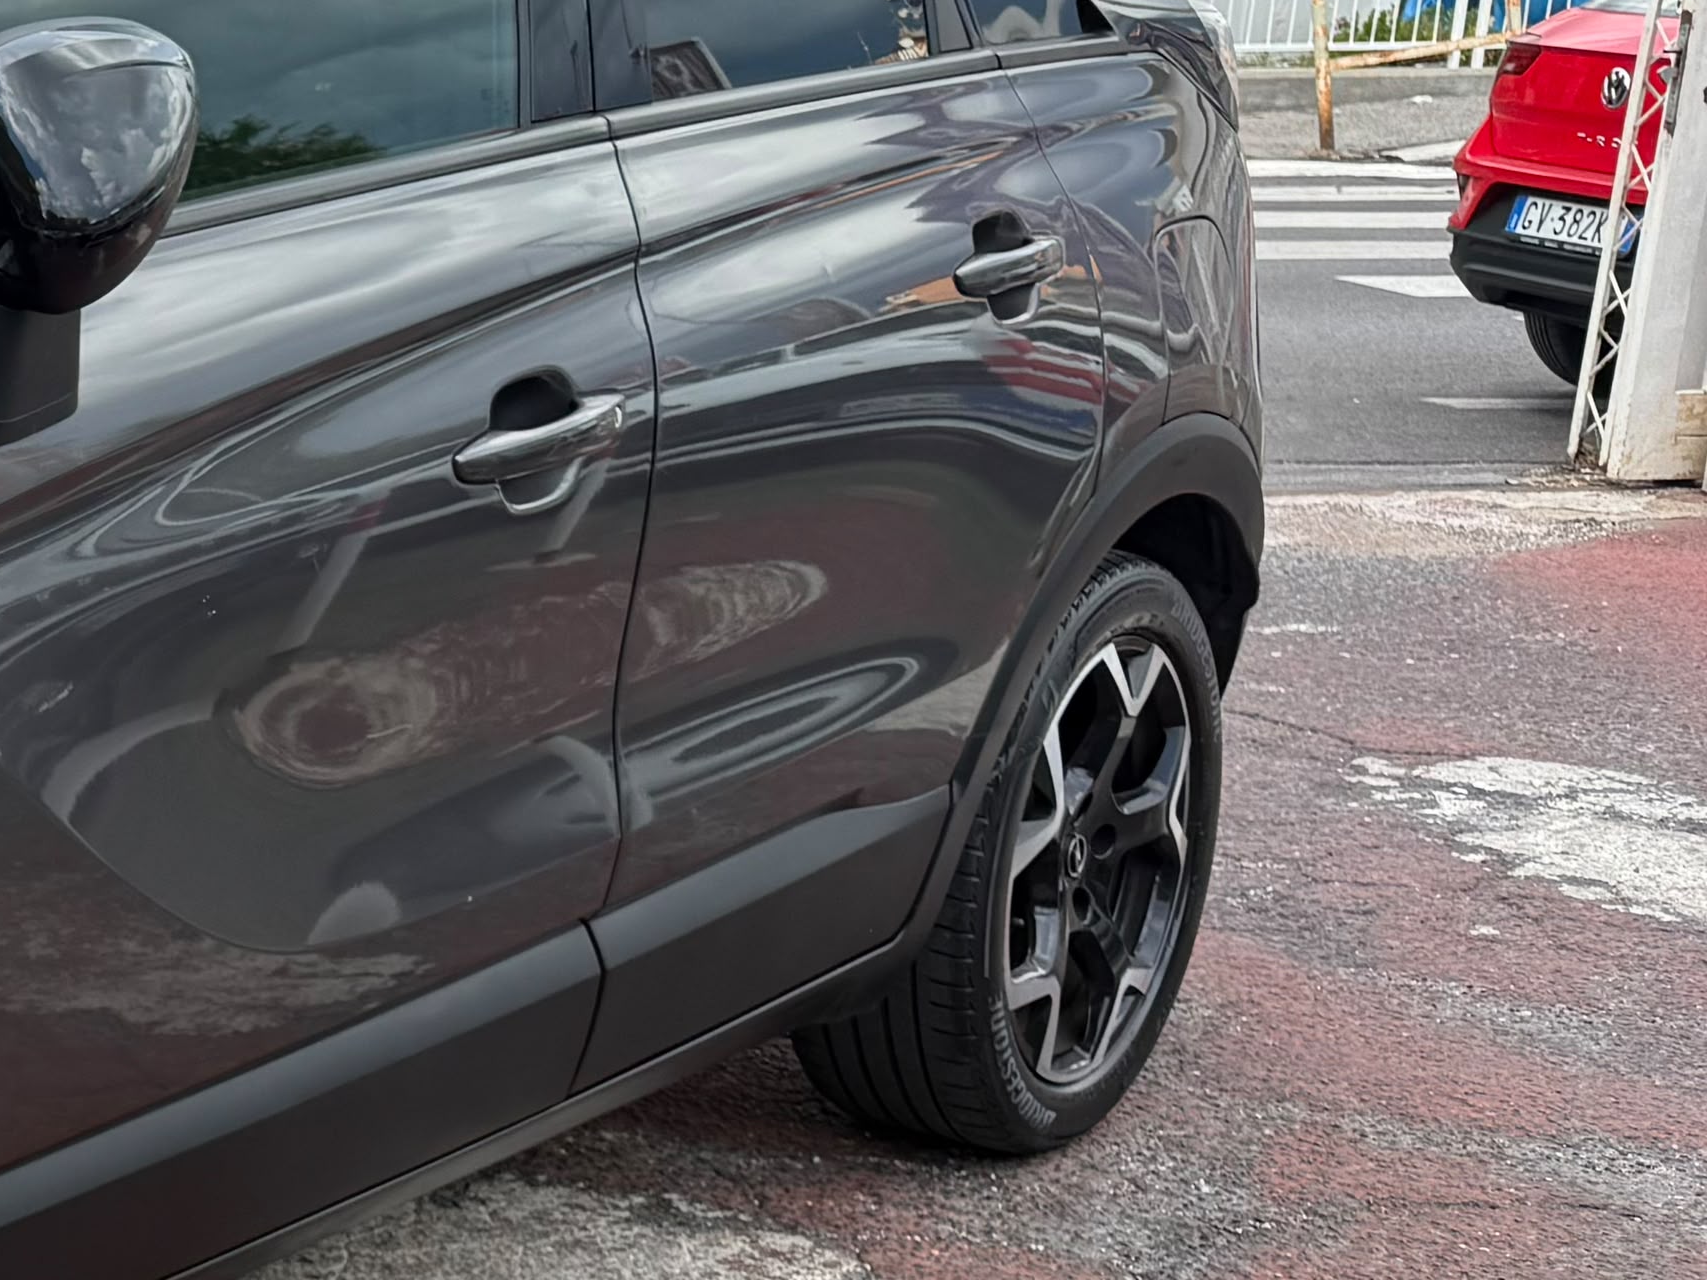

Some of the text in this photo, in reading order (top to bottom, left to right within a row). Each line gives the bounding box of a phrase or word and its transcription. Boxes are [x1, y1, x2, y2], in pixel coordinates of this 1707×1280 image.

[1521, 201, 1611, 244] GV 382K
[988, 990, 1058, 1131] BRIDGESTONE
